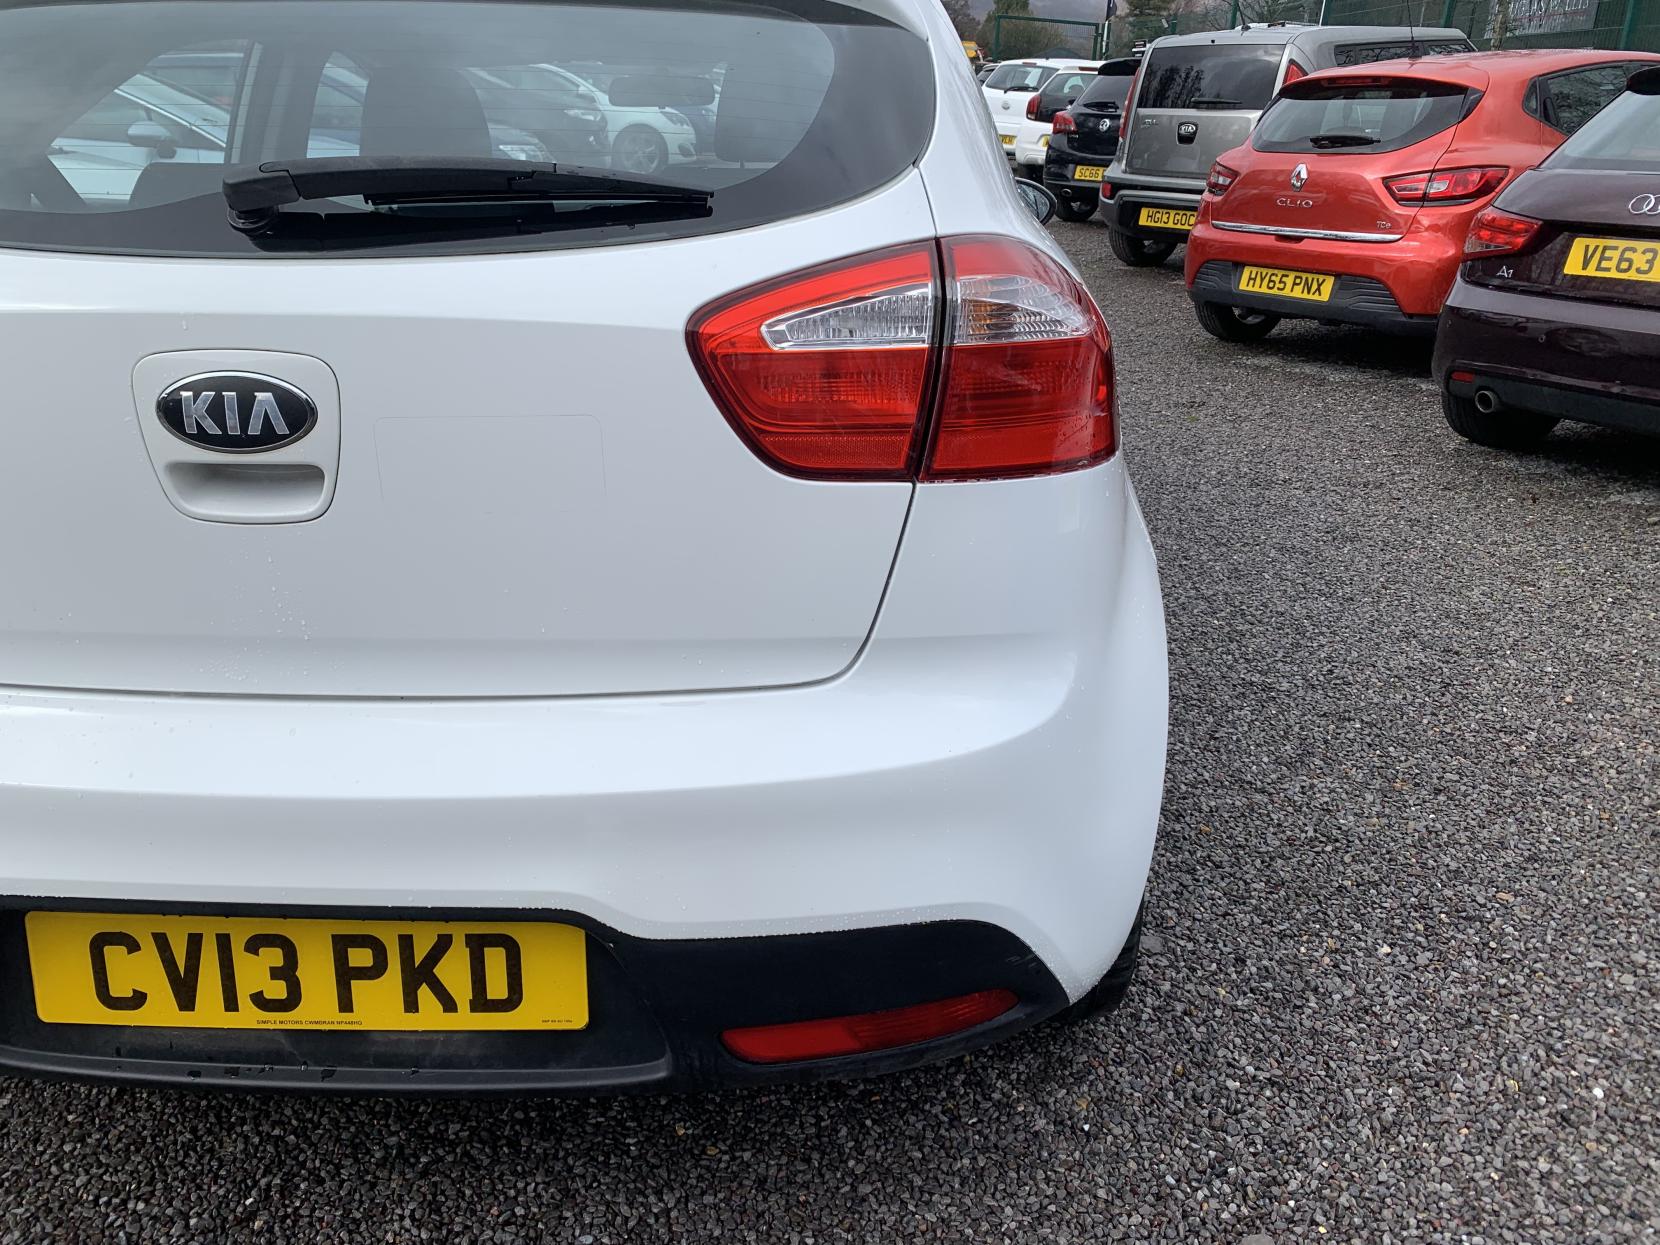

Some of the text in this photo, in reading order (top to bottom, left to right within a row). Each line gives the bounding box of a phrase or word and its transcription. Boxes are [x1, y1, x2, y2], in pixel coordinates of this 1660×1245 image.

[1078, 168, 1100, 178] SC66
[1277, 197, 1313, 208] CLIO
[1146, 210, 1171, 226] HG13
[1581, 244, 1659, 275] VE63
[1496, 265, 1514, 278] A1
[1246, 270, 1326, 297] HY65 PNX
[180, 391, 290, 435] KIA
[88, 931, 523, 1014] CV13 PKD
